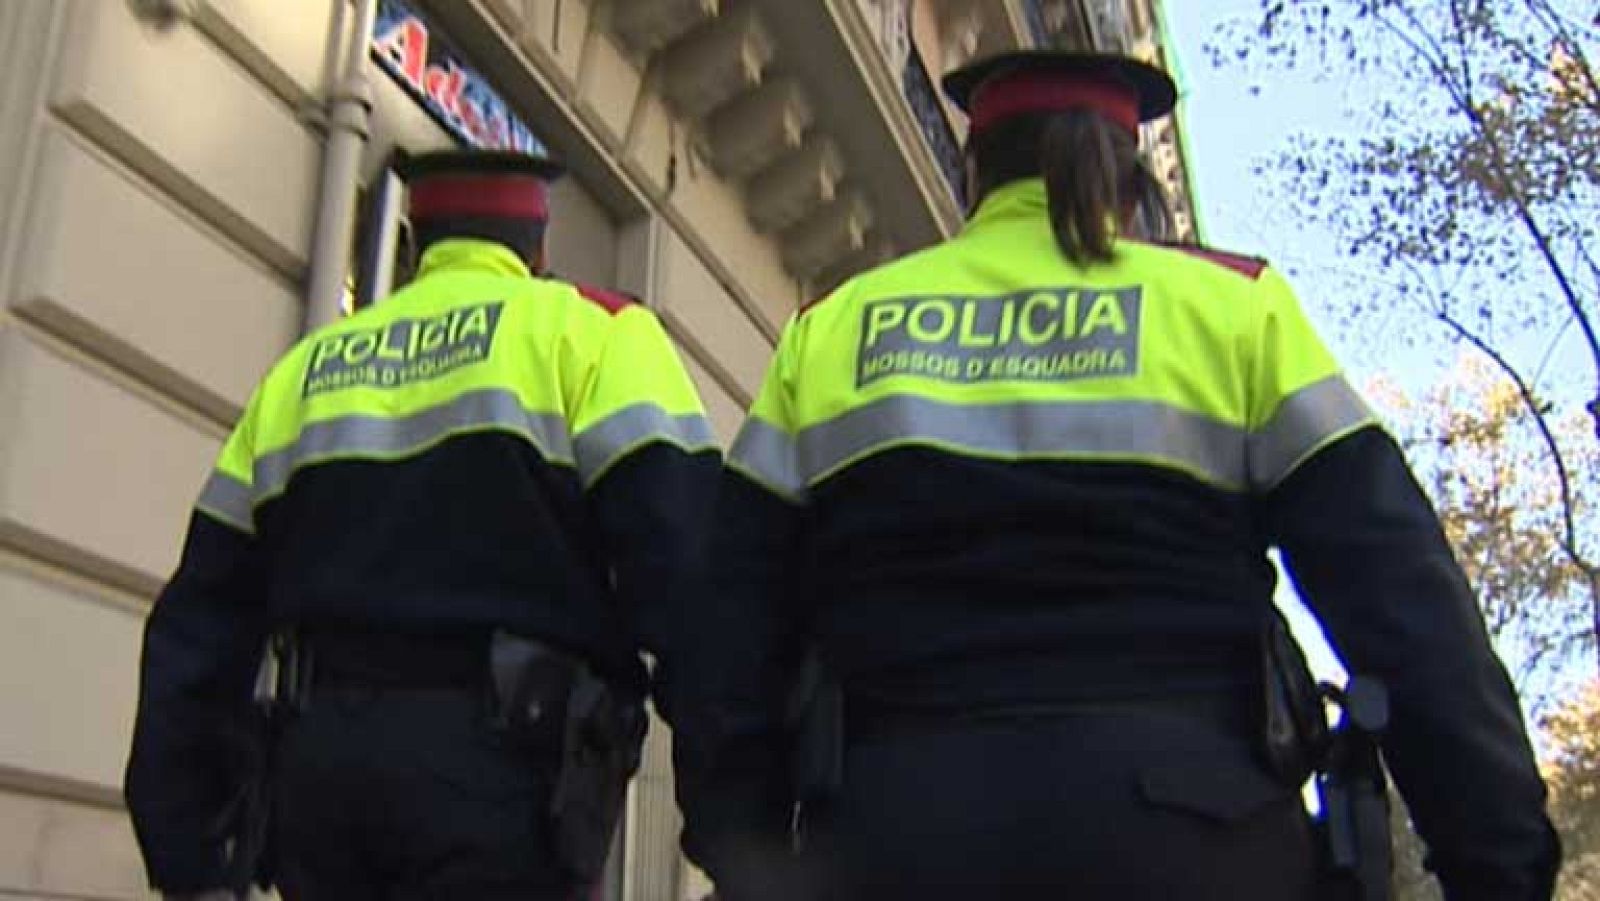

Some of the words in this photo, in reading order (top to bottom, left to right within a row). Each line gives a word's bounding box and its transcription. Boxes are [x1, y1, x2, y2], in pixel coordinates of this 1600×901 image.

[312, 305, 489, 371] POLICIA
[866, 291, 1127, 347] POLICIA
[863, 350, 959, 377] MOSSOS
